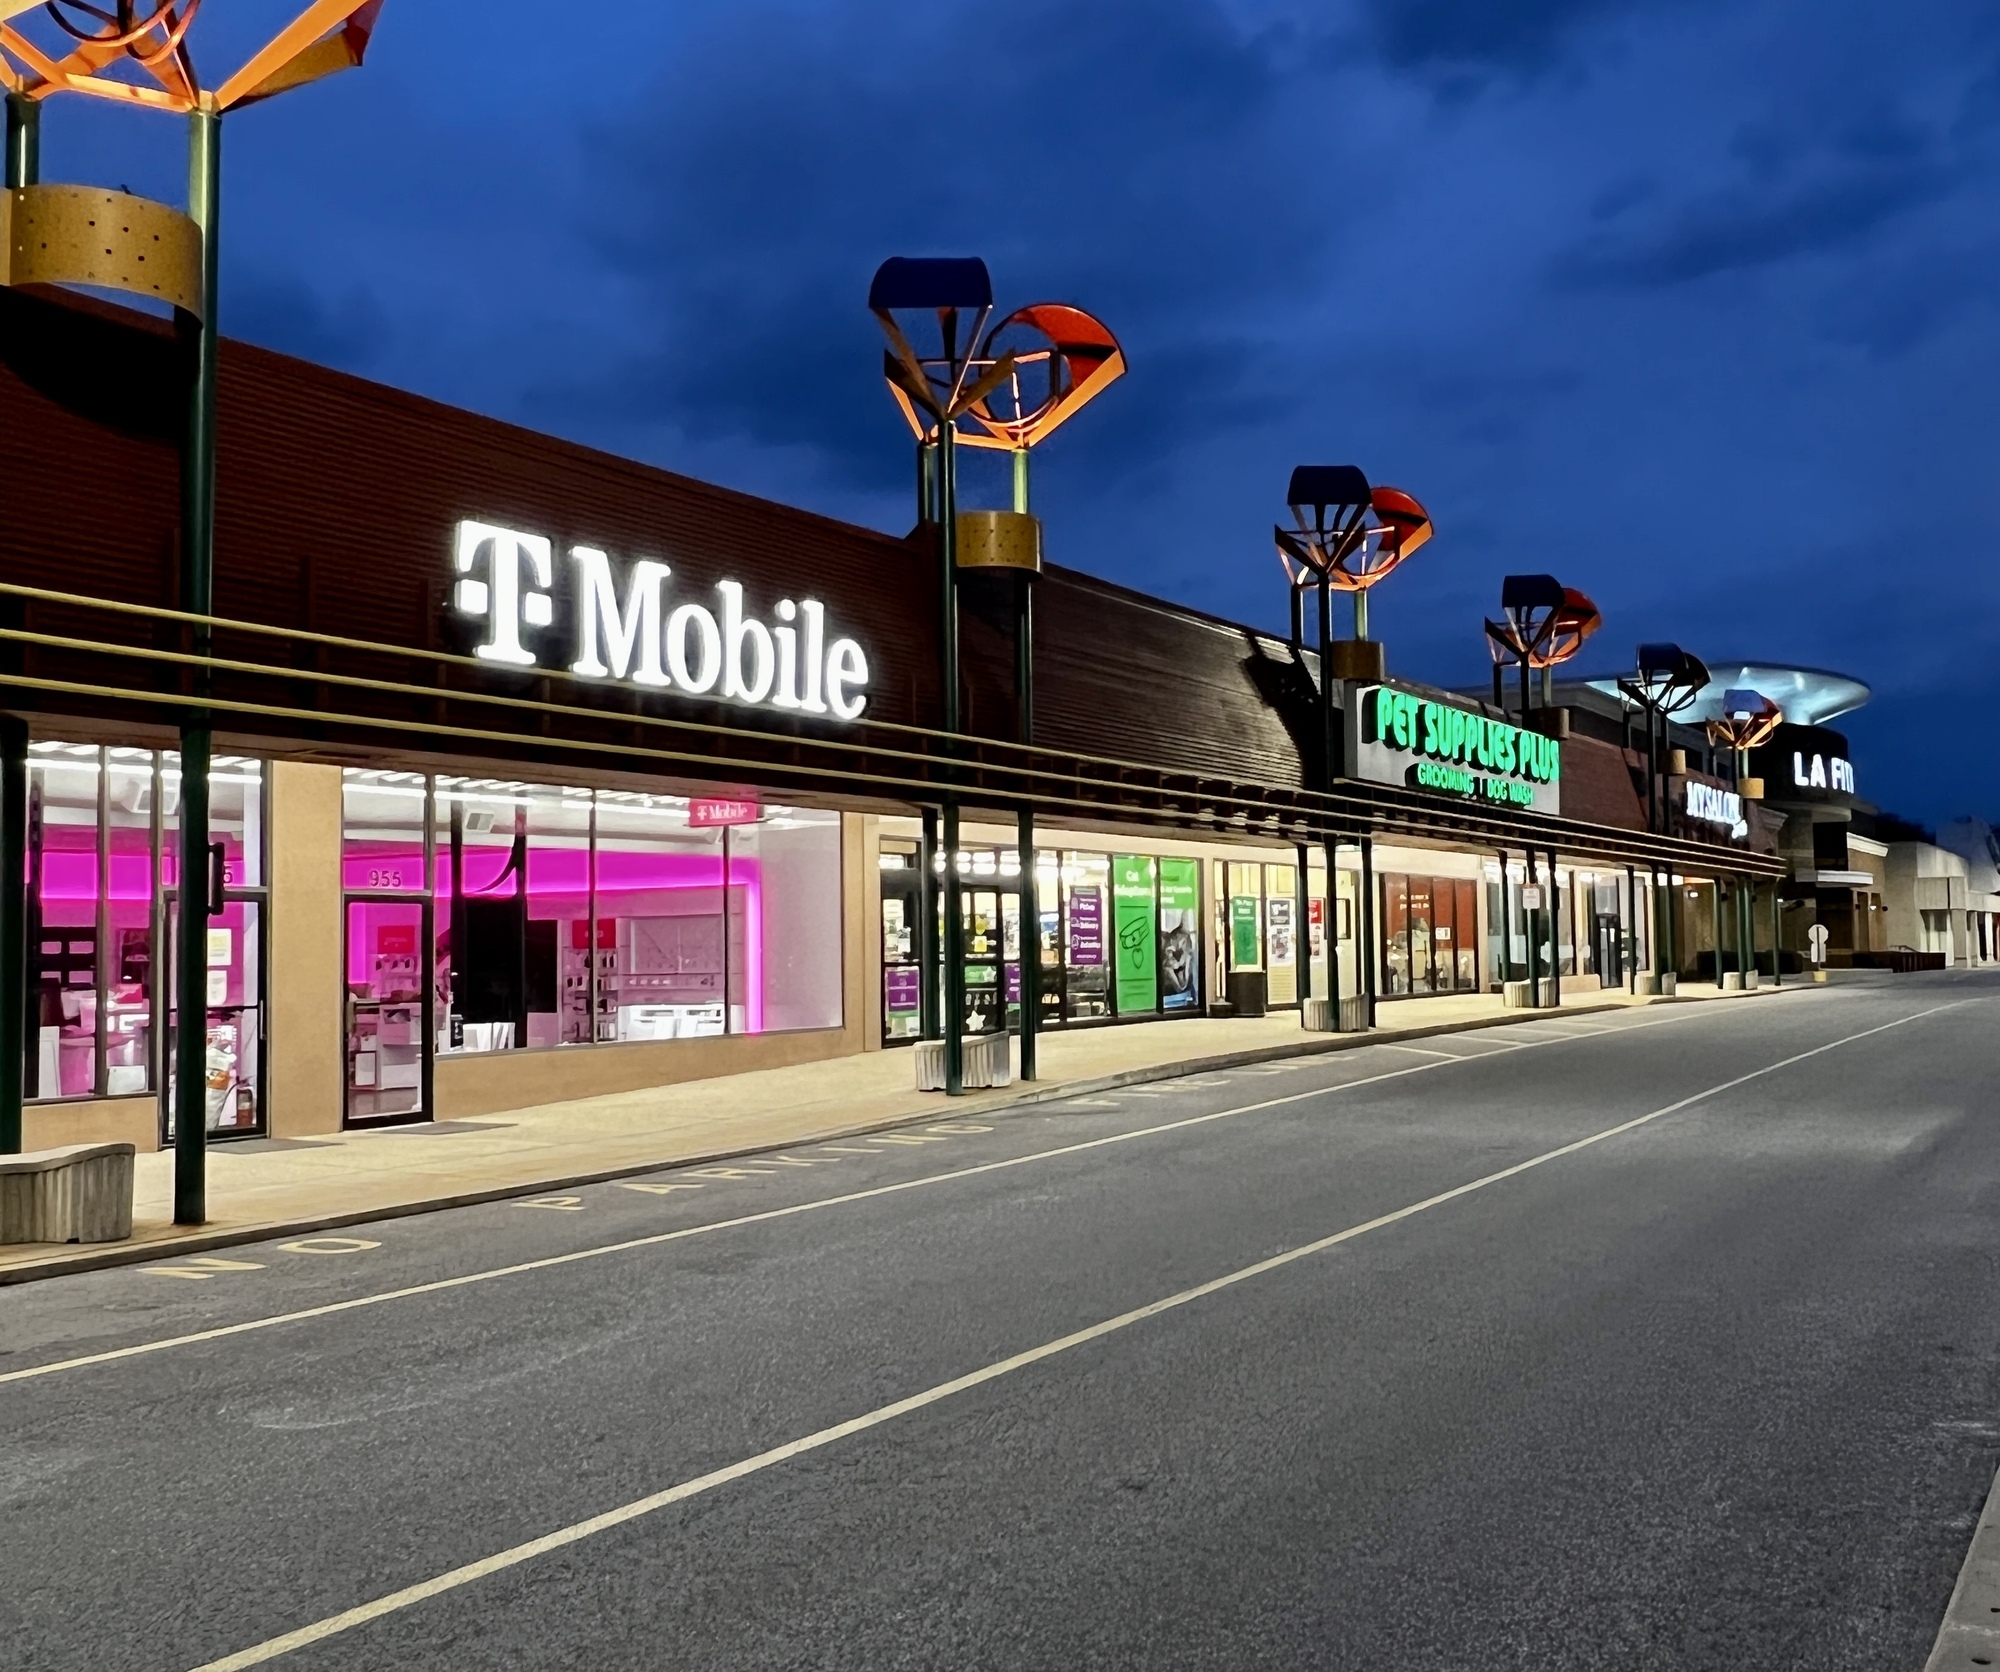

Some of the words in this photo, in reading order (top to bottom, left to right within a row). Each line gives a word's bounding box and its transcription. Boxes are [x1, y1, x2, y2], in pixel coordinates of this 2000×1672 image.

[568, 546, 869, 721] Mobile
[1377, 687, 1418, 748] PET
[1424, 702, 1515, 772] SUPPLIES
[1519, 730, 1560, 782] PLUS
[1417, 762, 1474, 794] GROOMING
[1487, 777, 1507, 801] DOG
[1508, 783, 1534, 806] WASH
[1793, 751, 1827, 789] LA
[709, 803, 748, 820] Mobile
[368, 869, 401, 888] 955
[134, 1237, 383, 1280] NO
[510, 1123, 996, 1211] PARKING
